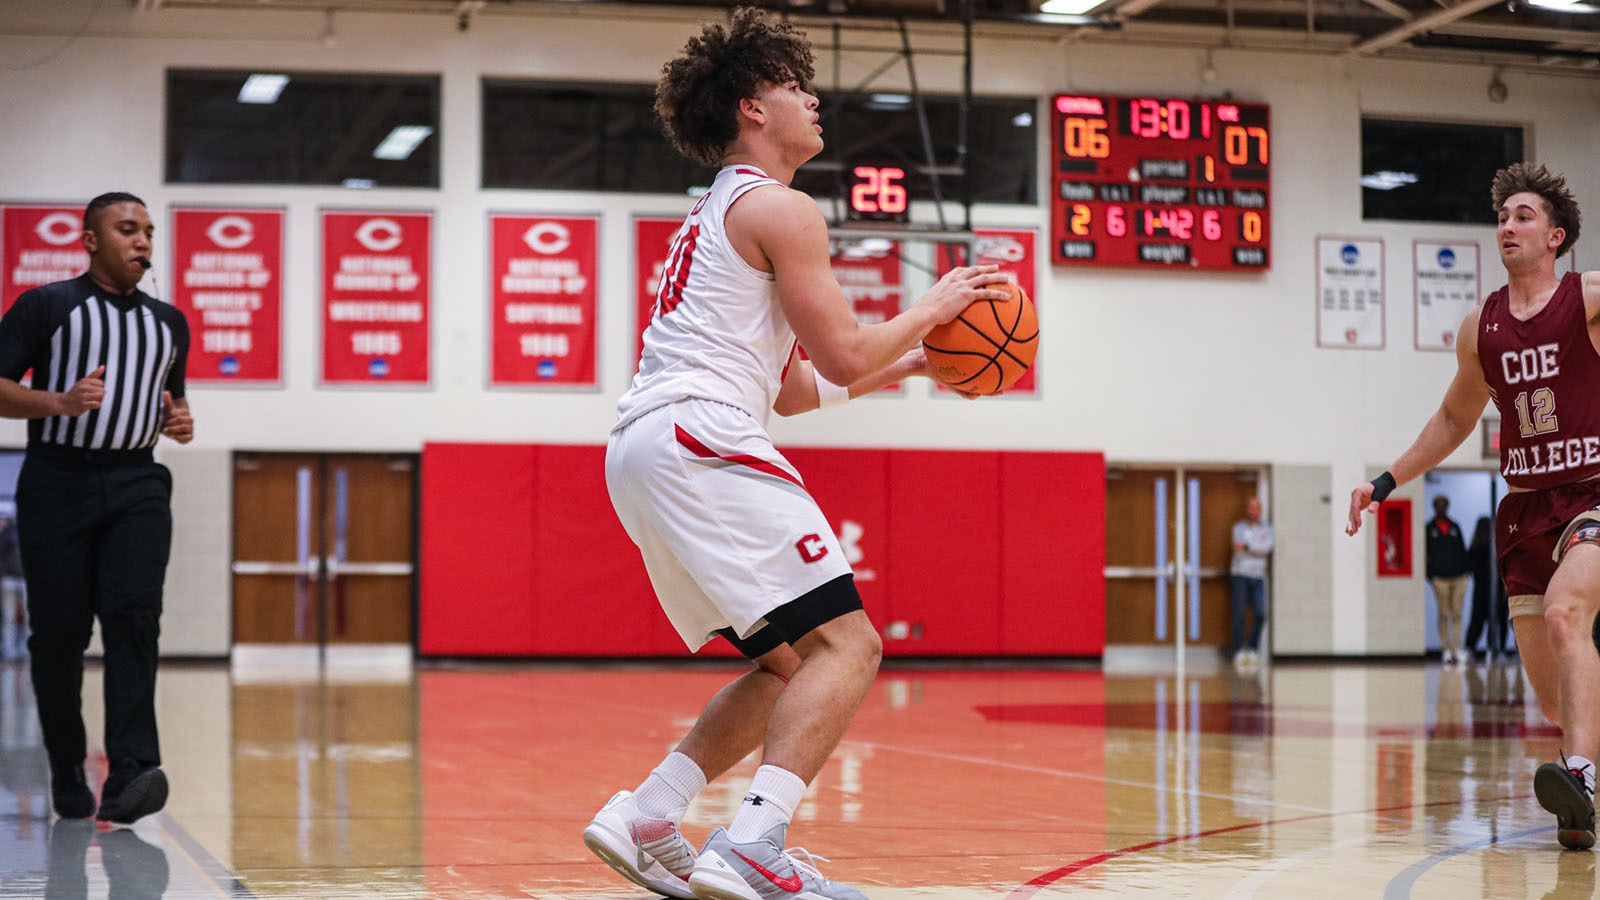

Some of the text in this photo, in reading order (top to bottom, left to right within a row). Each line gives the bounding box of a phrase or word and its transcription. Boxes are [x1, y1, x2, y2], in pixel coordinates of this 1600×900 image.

[1131, 99, 1210, 139] 13:01
[1064, 117, 1109, 158] 06
[1225, 126, 1268, 164] 07
[1205, 155, 1214, 182] 1
[852, 166, 906, 212] 26
[1071, 204, 1091, 235] 2
[1106, 206, 1126, 236] 6
[1203, 209, 1222, 240] 6
[1243, 211, 1262, 242] 0
[1501, 342, 1560, 385] COE
[1514, 387, 1559, 438] 12
[796, 533, 828, 564] C
